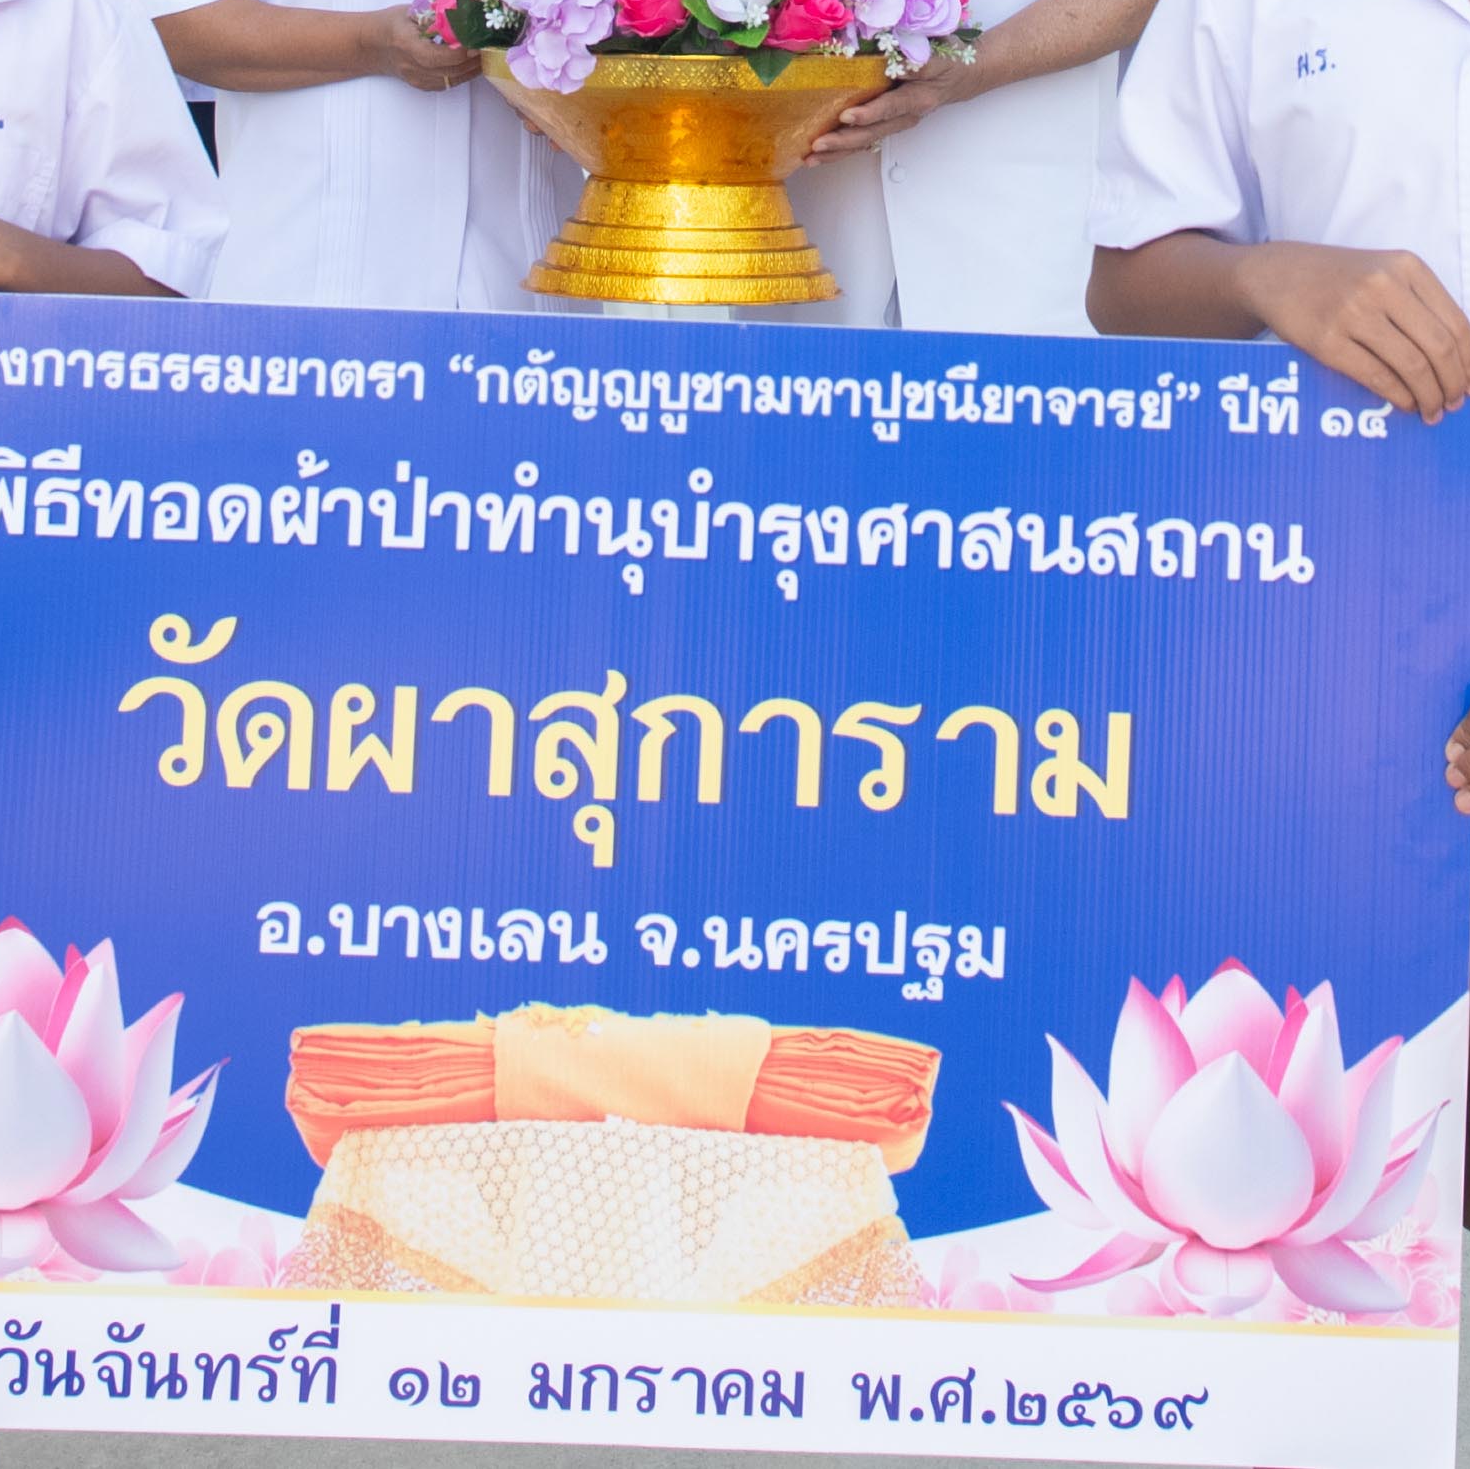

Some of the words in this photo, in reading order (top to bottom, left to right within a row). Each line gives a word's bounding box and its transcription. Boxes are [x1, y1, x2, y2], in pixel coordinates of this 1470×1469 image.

[449, 349, 1200, 442] “กตัญญูบูชามหาปูชนียาจารย์”
[1217, 360, 1300, 436] ปีที่
[1319, 401, 1394, 439] ๑๔
[117, 613, 1132, 869] วัดผาสุการาม
[256, 900, 608, 965] อ.บางเลน
[634, 910, 1006, 1001] จ.นครปฐม
[388, 1361, 482, 1408] ๑๒
[528, 1360, 806, 1420] มกราคม
[851, 1366, 1209, 1431] พ.ศ.๒๕๖๙
